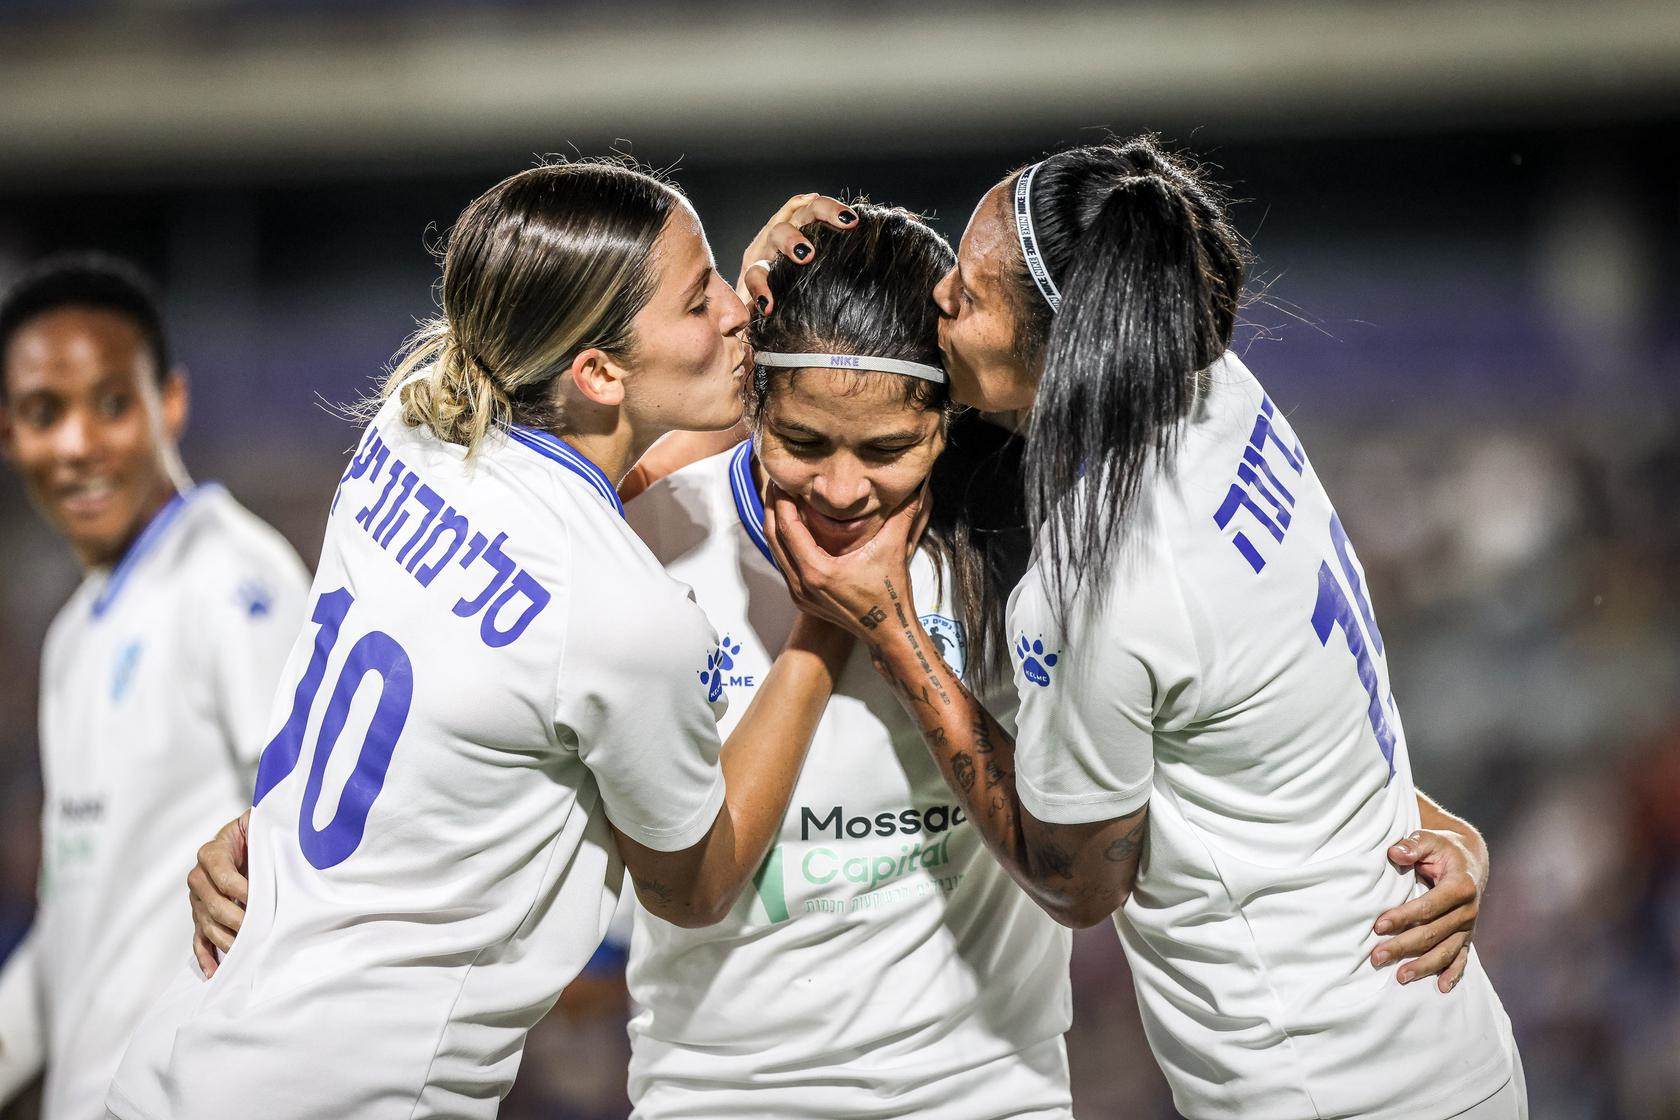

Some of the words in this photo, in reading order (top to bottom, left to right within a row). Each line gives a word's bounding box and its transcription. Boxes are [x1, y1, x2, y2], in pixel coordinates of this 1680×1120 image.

[1019, 216, 1031, 235] NIKE
[1023, 237, 1036, 256] NIKE
[830, 355, 860, 367] NIKE
[252, 586, 414, 870] 10
[802, 833, 950, 888] Capital
